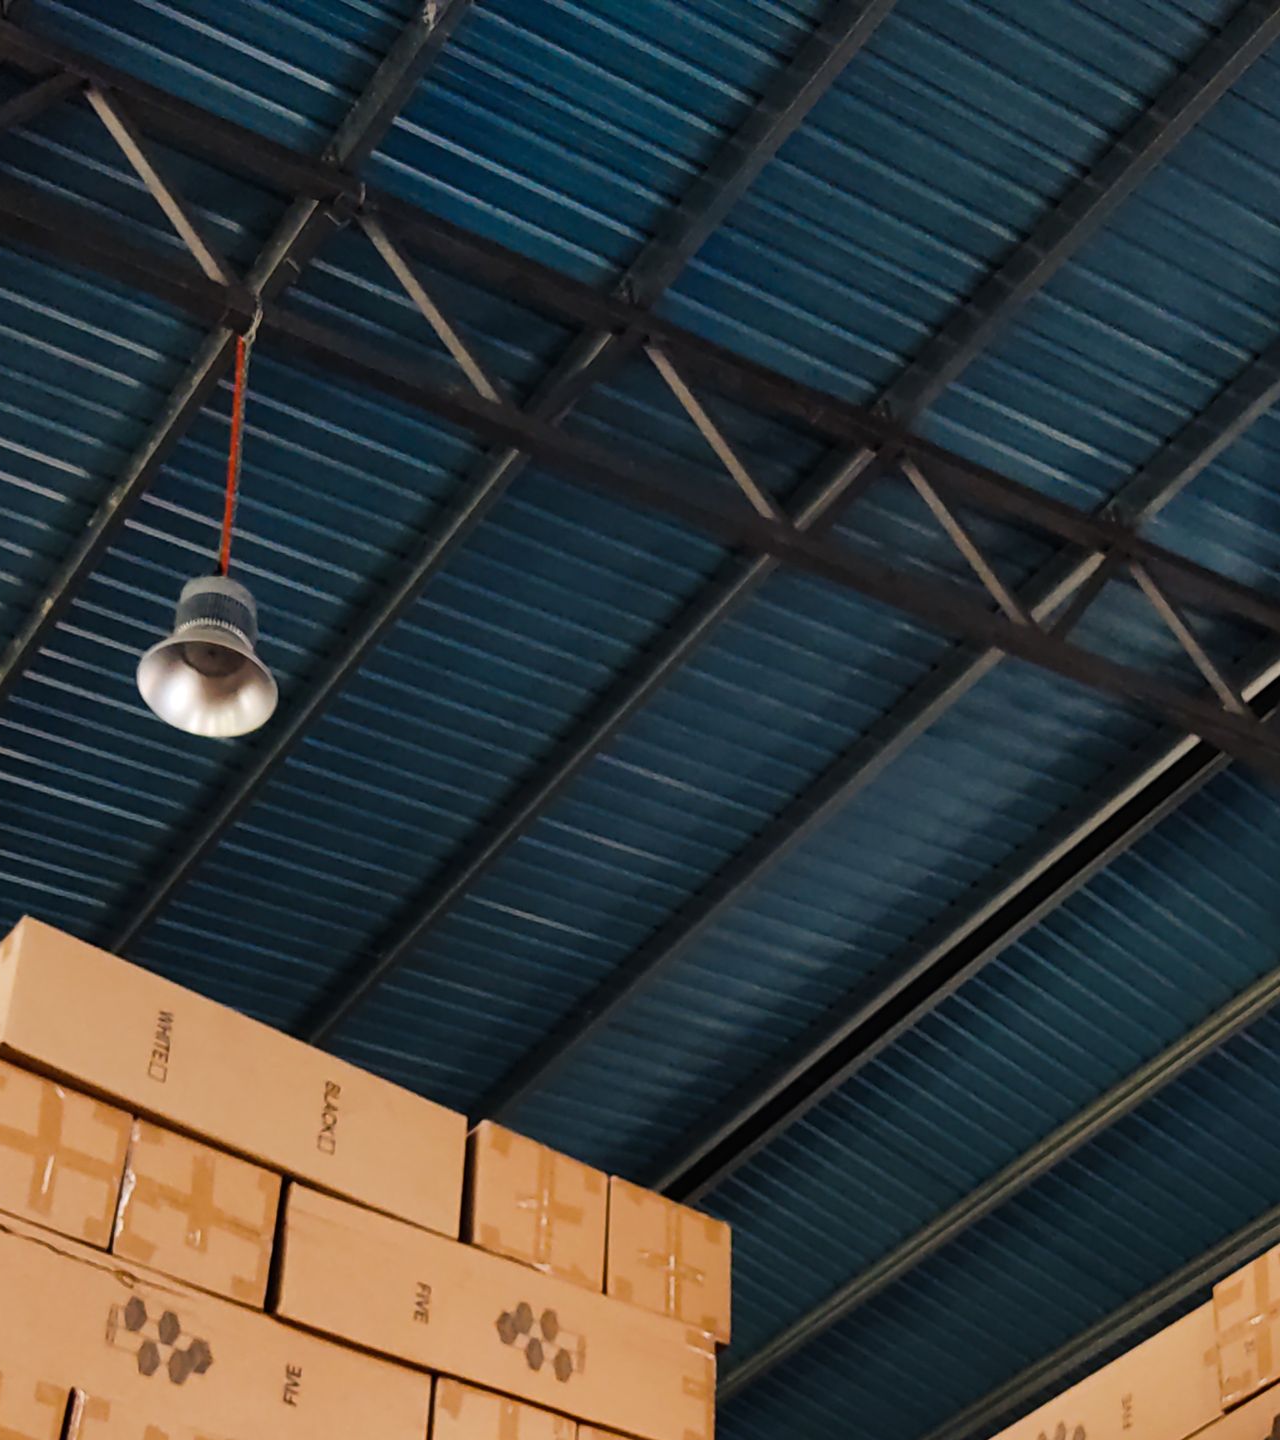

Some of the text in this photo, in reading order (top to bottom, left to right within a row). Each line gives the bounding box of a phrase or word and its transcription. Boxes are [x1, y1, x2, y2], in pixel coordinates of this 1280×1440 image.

[152, 1010, 174, 1062] WHITE
[320, 1080, 341, 1136] BLACK
[413, 1281, 432, 1324] FIVE
[283, 1362, 302, 1407] FIVE
